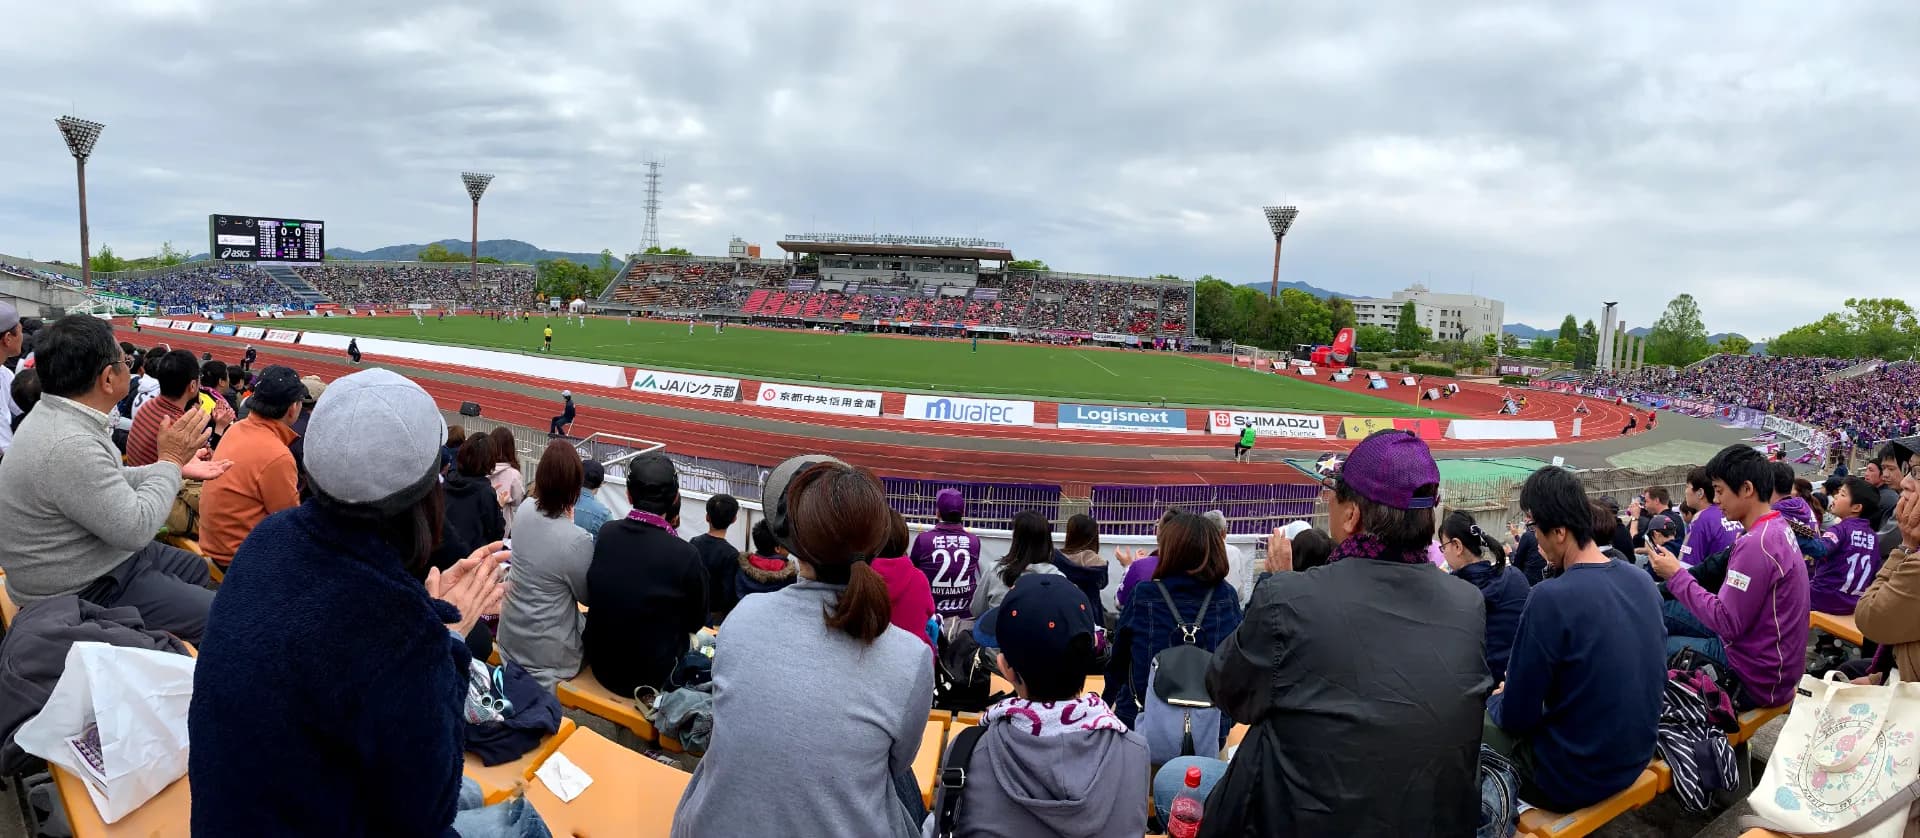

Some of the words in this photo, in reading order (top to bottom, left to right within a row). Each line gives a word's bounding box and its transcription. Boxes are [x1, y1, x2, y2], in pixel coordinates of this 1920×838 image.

[281, 227, 287, 236] 0
[295, 228, 301, 237] 0
[231, 249, 251, 257] asics
[779, 391, 877, 409] 京都中央信用金庫
[1077, 407, 1169, 424] Logisnext
[1233, 415, 1320, 430] SHIMADZU
[933, 535, 970, 548] 任天堂
[932, 549, 971, 587] 22
